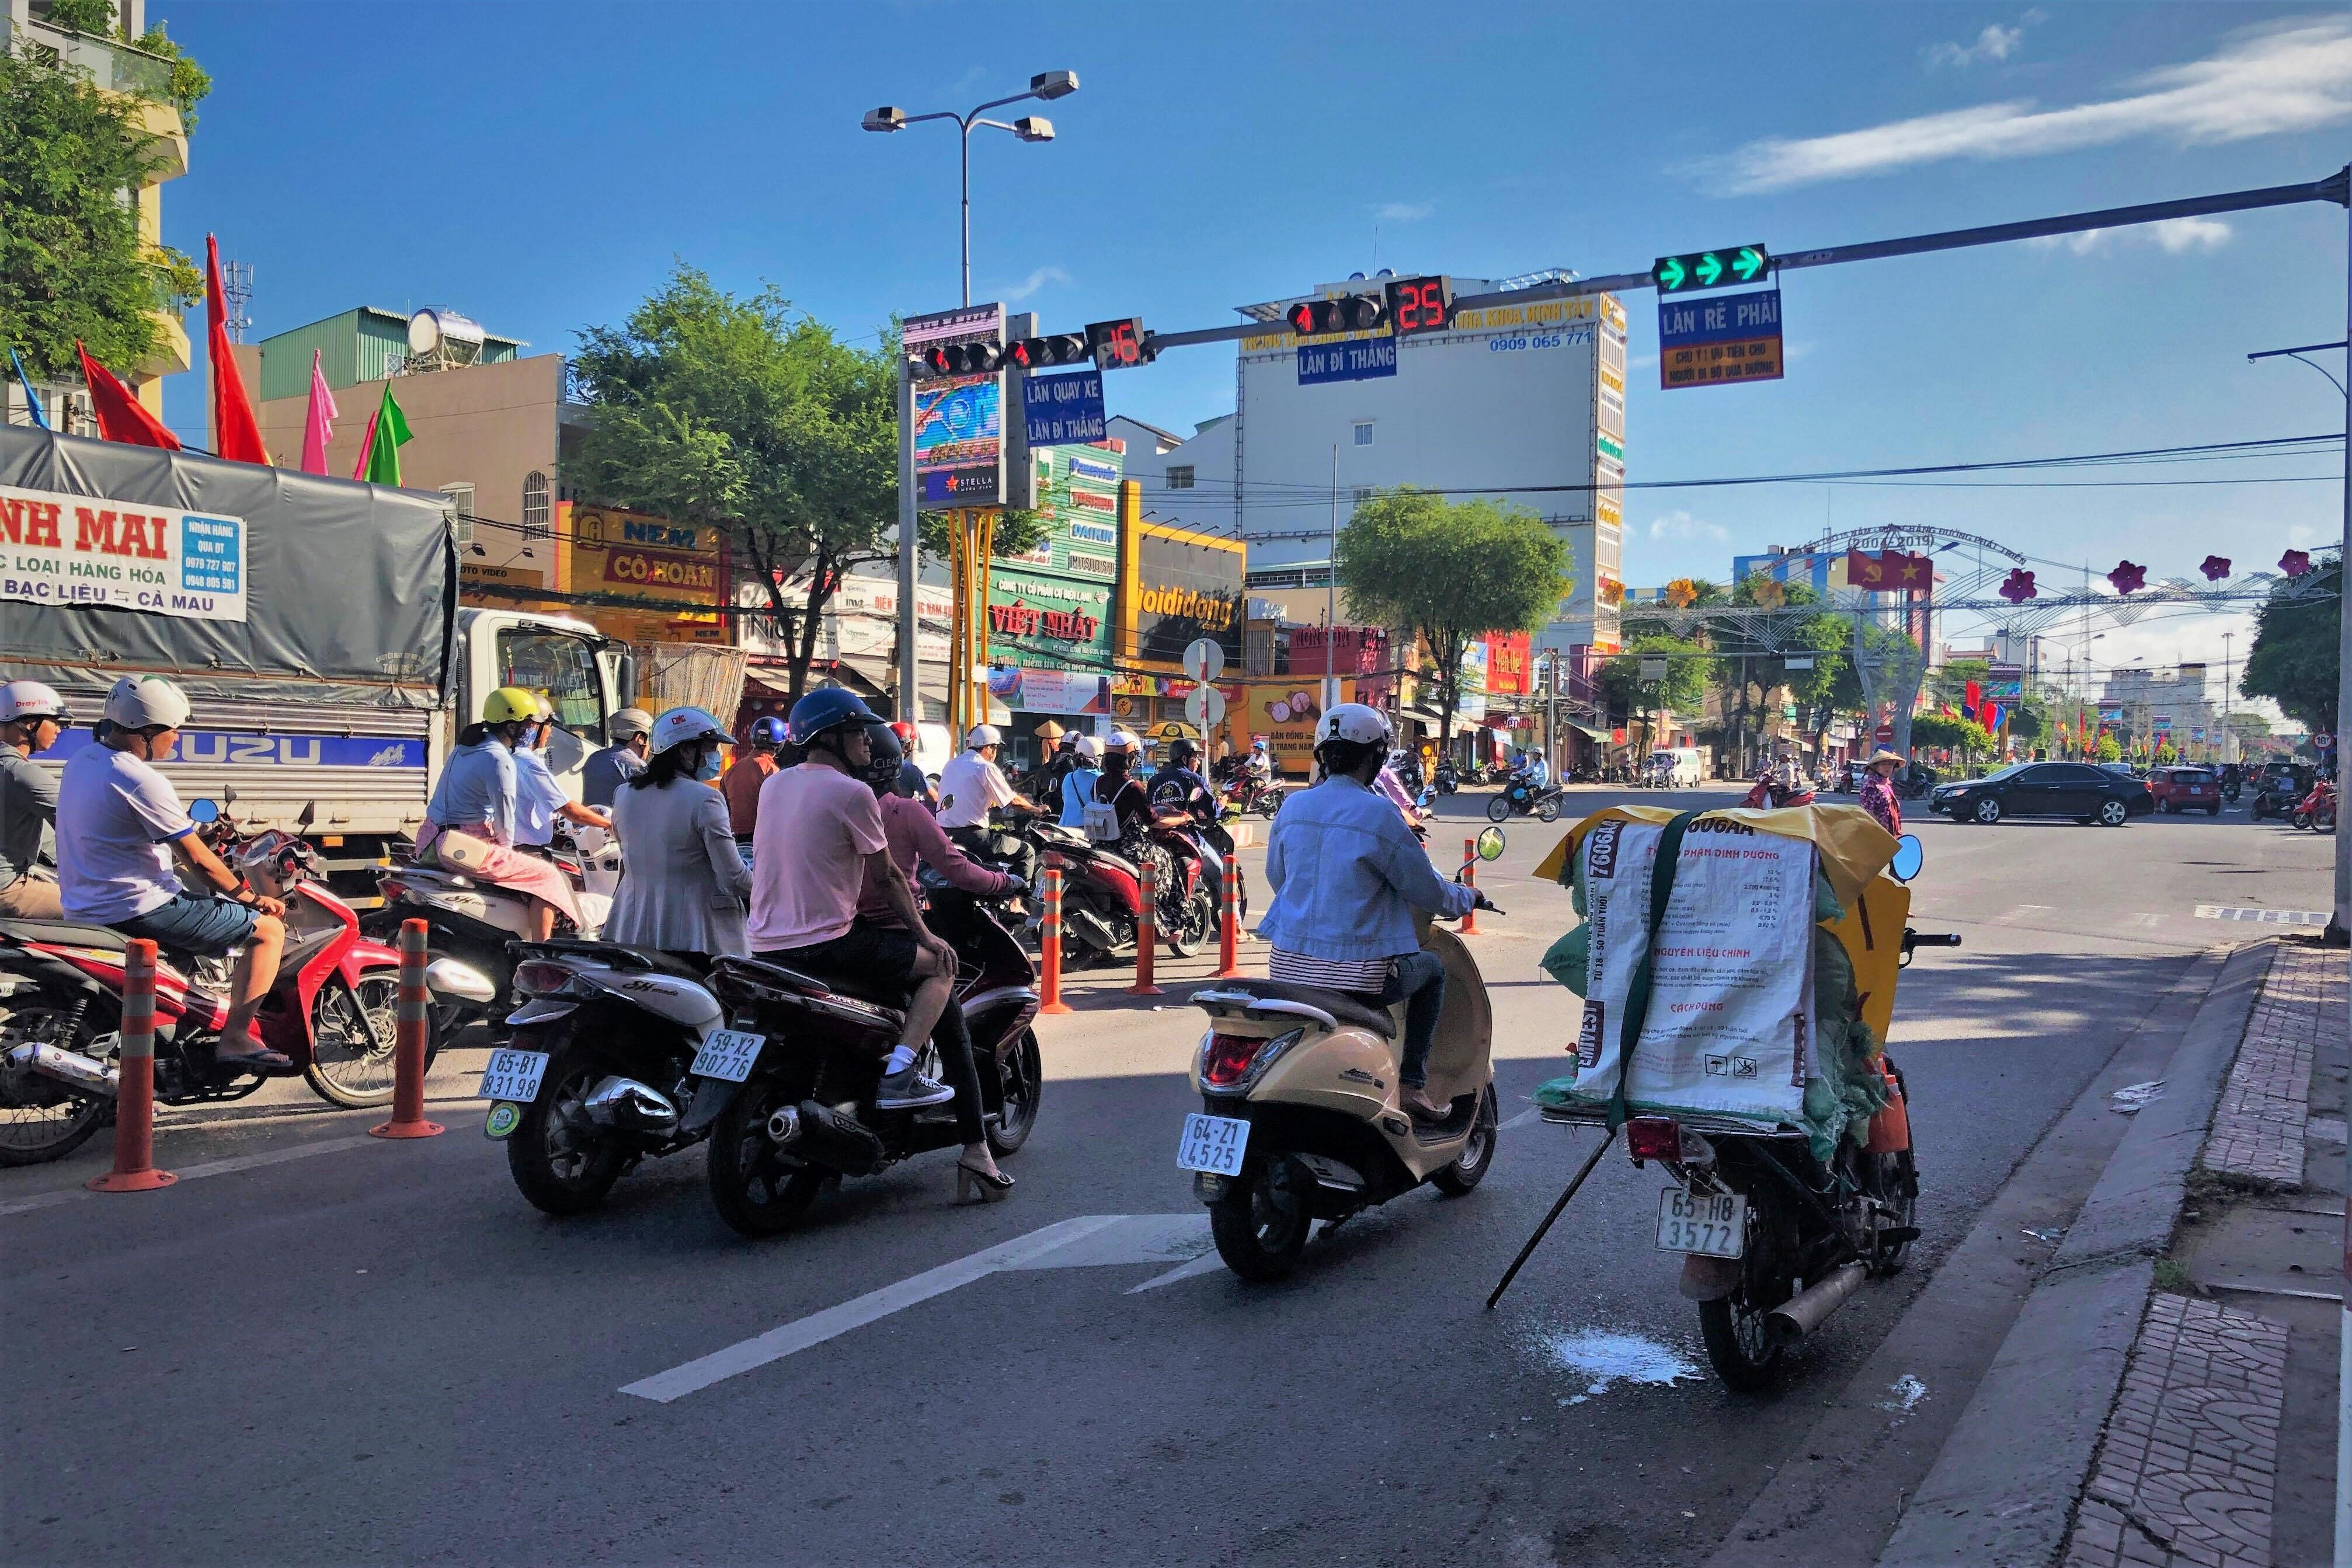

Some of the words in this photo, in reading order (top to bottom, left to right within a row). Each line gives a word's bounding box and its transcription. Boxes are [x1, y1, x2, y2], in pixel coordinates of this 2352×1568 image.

[1399, 283, 1443, 329] 25
[1485, 308, 1522, 327] KHOA
[1664, 307, 1695, 335] LÀN
[1704, 302, 1727, 331] RẼ
[1737, 294, 1777, 326] PHẢI
[1111, 323, 1138, 362] 16
[1490, 338, 1527, 353] 0909
[1532, 336, 1561, 349] 065
[1566, 332, 1592, 346] 771
[1299, 350, 1324, 375] LÀN
[1349, 337, 1394, 370] THẲNG
[1027, 381, 1049, 403] LÀN
[1053, 381, 1080, 403] QUAY
[1084, 379, 1099, 398] XE
[1028, 419, 1050, 441] LÀN
[1065, 410, 1103, 437] THẲNG
[961, 476, 992, 487] STELLA
[1071, 492, 1115, 512] TOSHIBA
[75, 507, 168, 560] MAI
[1072, 524, 1114, 543] DAIKIN
[198, 540, 213, 553] QUA
[16, 556, 60, 578] LOẠI
[69, 559, 121, 580] HÀNG
[130, 566, 166, 584] HÓA
[186, 556, 204, 570] 0979
[206, 558, 221, 571] 727
[482, 568, 507, 578] VIDEO
[615, 553, 648, 580] CÔ
[1070, 555, 1115, 575] MITSUBISHI
[4, 579, 50, 600] BẠC
[137, 591, 165, 608] CÀ
[172, 595, 214, 612] MAU
[989, 598, 1041, 639] VIỆT
[1042, 606, 1099, 643] NHẬT
[1043, 658, 1055, 668] tin
[1687, 817, 1755, 837] 606AA
[1596, 939, 1605, 950] 50
[1595, 957, 1604, 969] 18
[711, 1033, 755, 1057] 59-X2
[496, 1053, 538, 1076] 65-B1
[695, 1052, 749, 1078] 907.76
[483, 1075, 537, 1098] 831.98
[1194, 1118, 1238, 1145] 64-Z1
[1188, 1142, 1236, 1169] 4525
[1668, 1220, 1731, 1252] 3572
